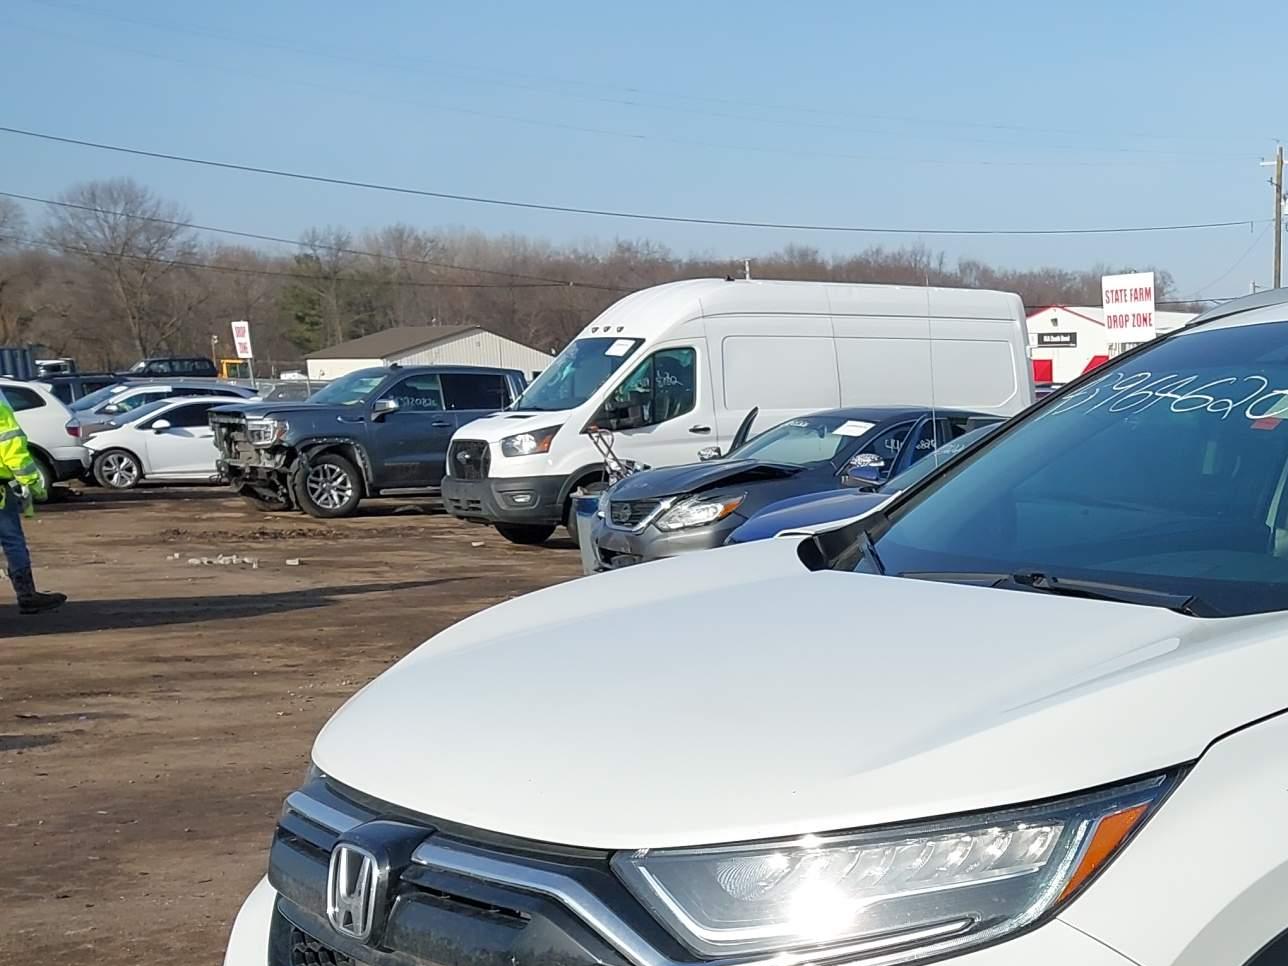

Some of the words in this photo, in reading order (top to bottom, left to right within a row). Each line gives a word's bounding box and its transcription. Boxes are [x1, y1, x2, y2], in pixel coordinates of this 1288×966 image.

[1105, 289, 1128, 304] STATE
[1130, 287, 1151, 302] FARM
[1107, 314, 1129, 329] DROP
[1132, 312, 1152, 327] ZONE
